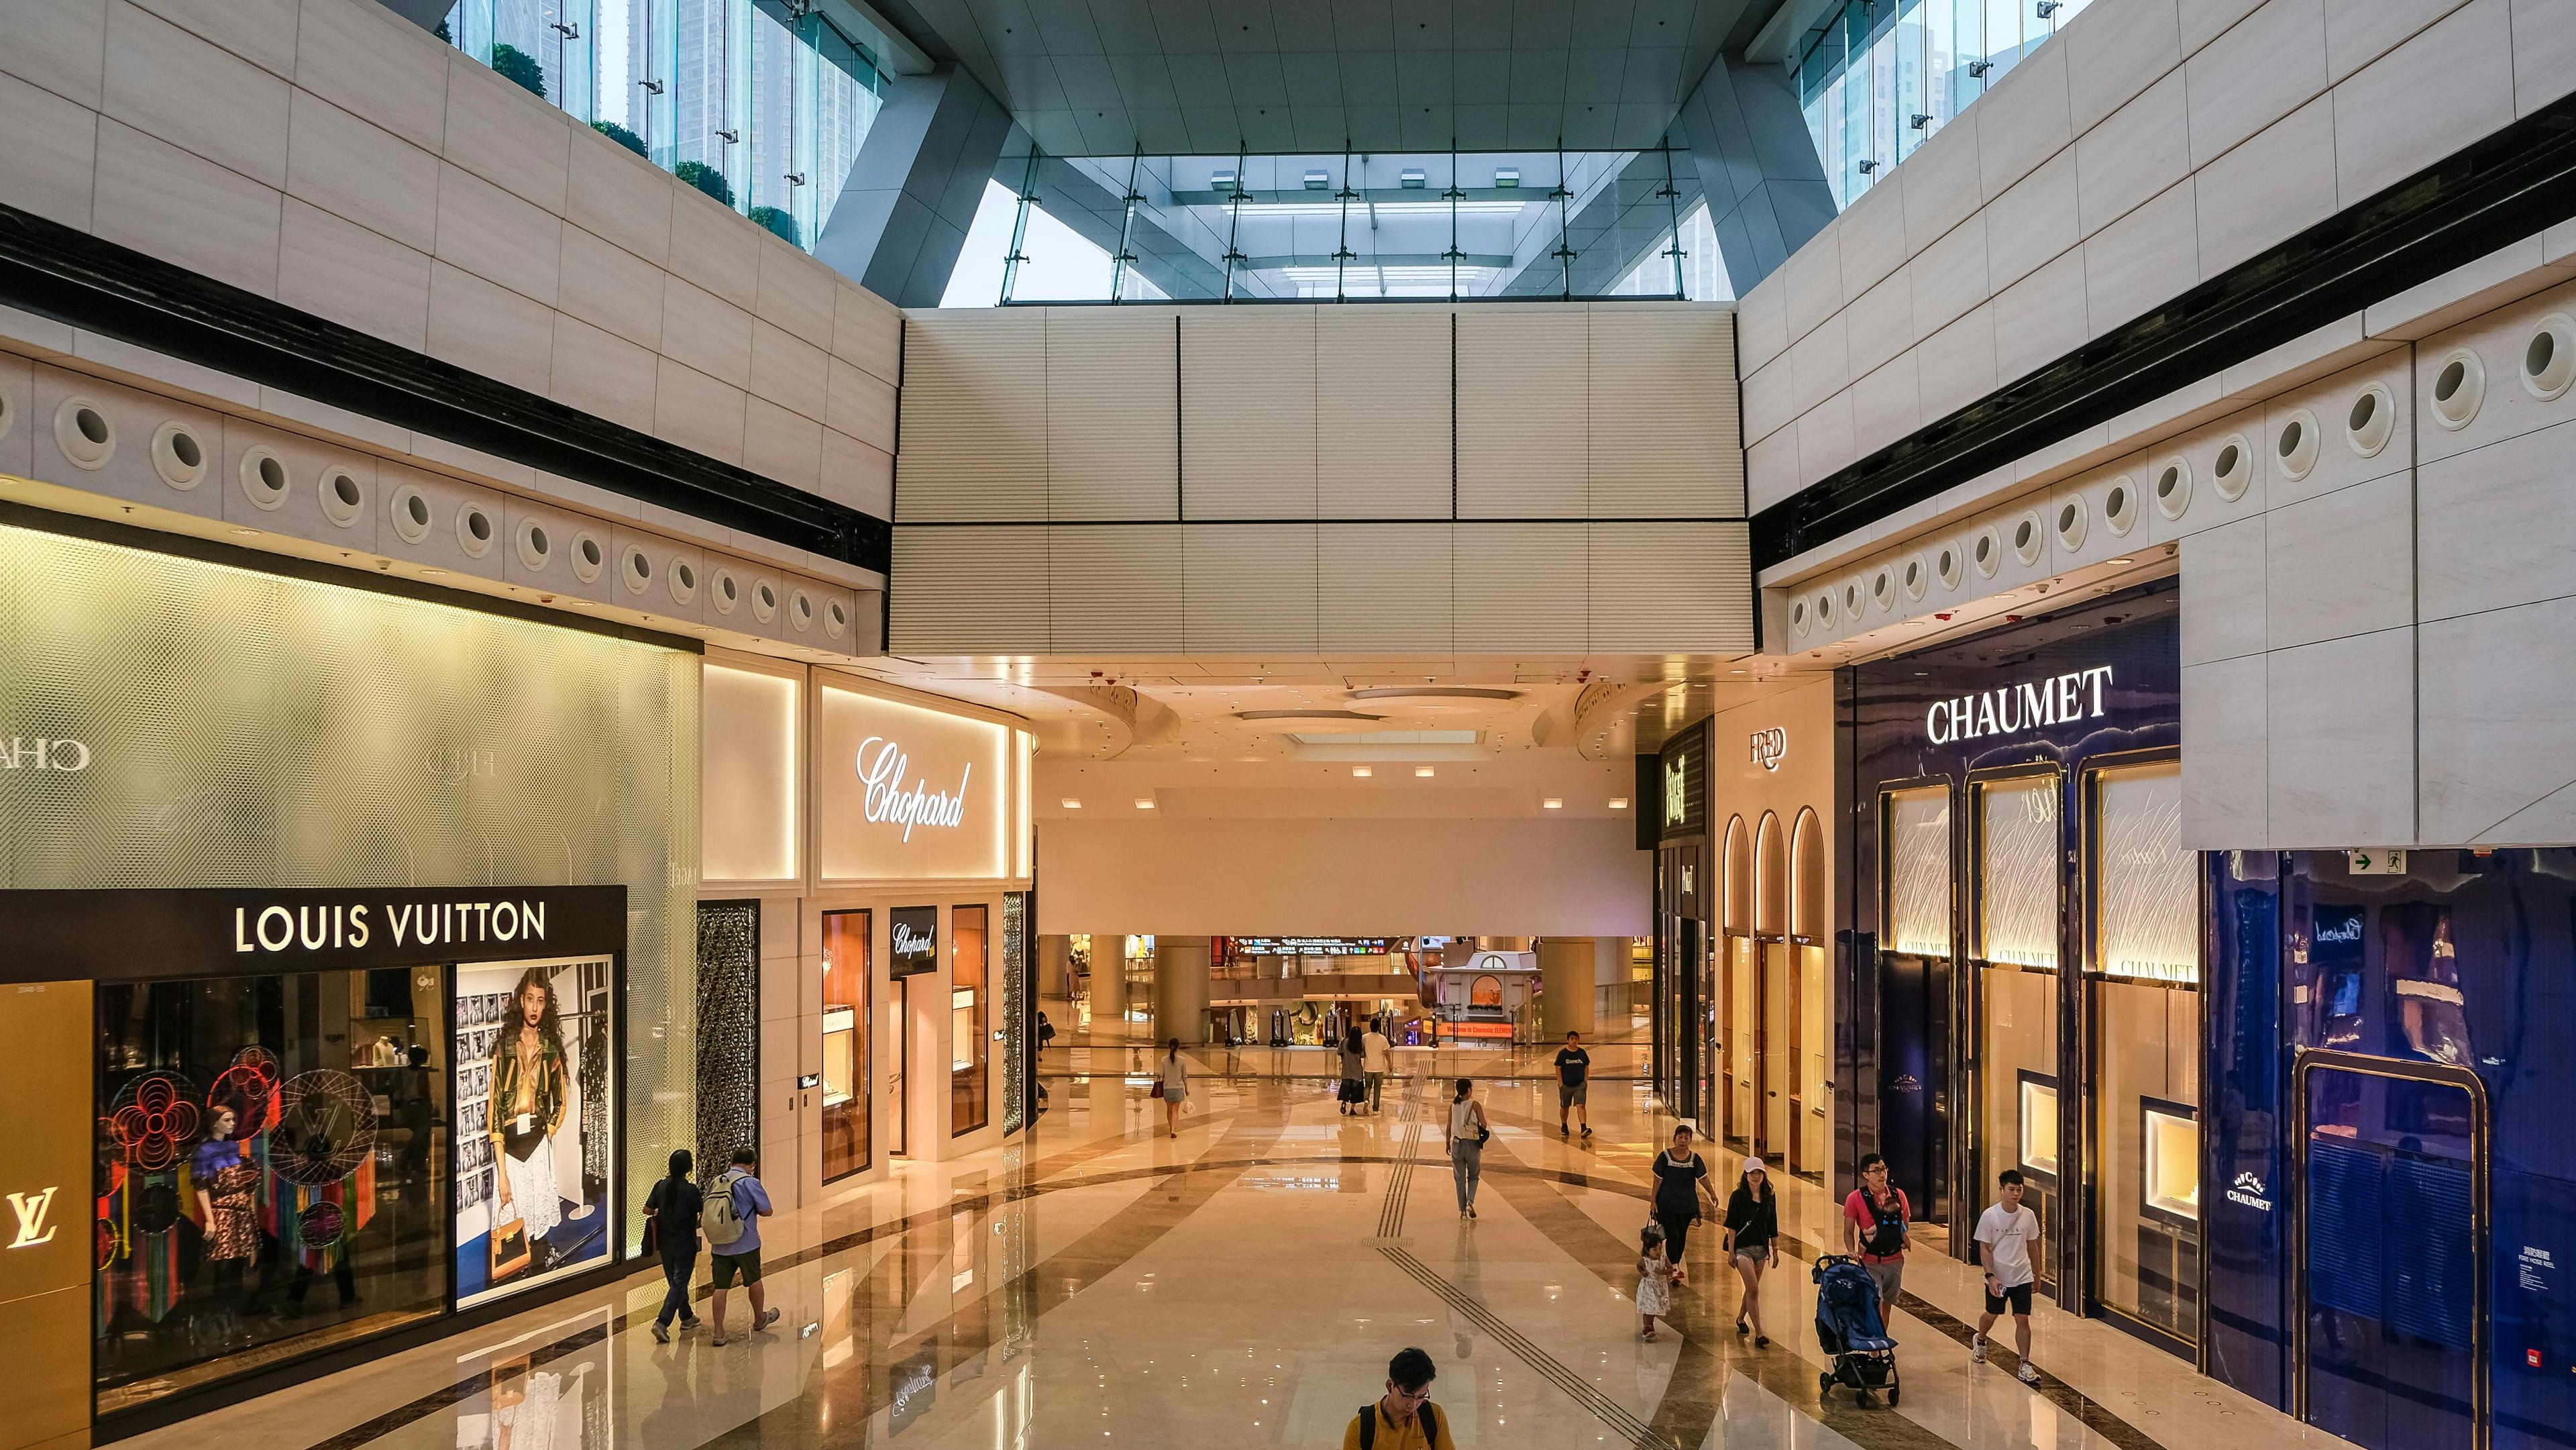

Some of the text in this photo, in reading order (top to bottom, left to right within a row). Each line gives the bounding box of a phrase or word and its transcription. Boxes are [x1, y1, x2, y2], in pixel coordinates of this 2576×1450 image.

[1927, 665, 2113, 745] CHAUMET
[1750, 727, 1786, 772] FRED
[856, 736, 971, 843] Chopard
[235, 899, 545, 953] LOUIS VUITTON
[893, 923, 934, 960] Chopard
[1999, 949, 2055, 968] CHAUMET
[2121, 960, 2193, 982] CHAUMET
[6, 1186, 59, 1249] LV
[2227, 1190, 2272, 1211] CHAUMET
